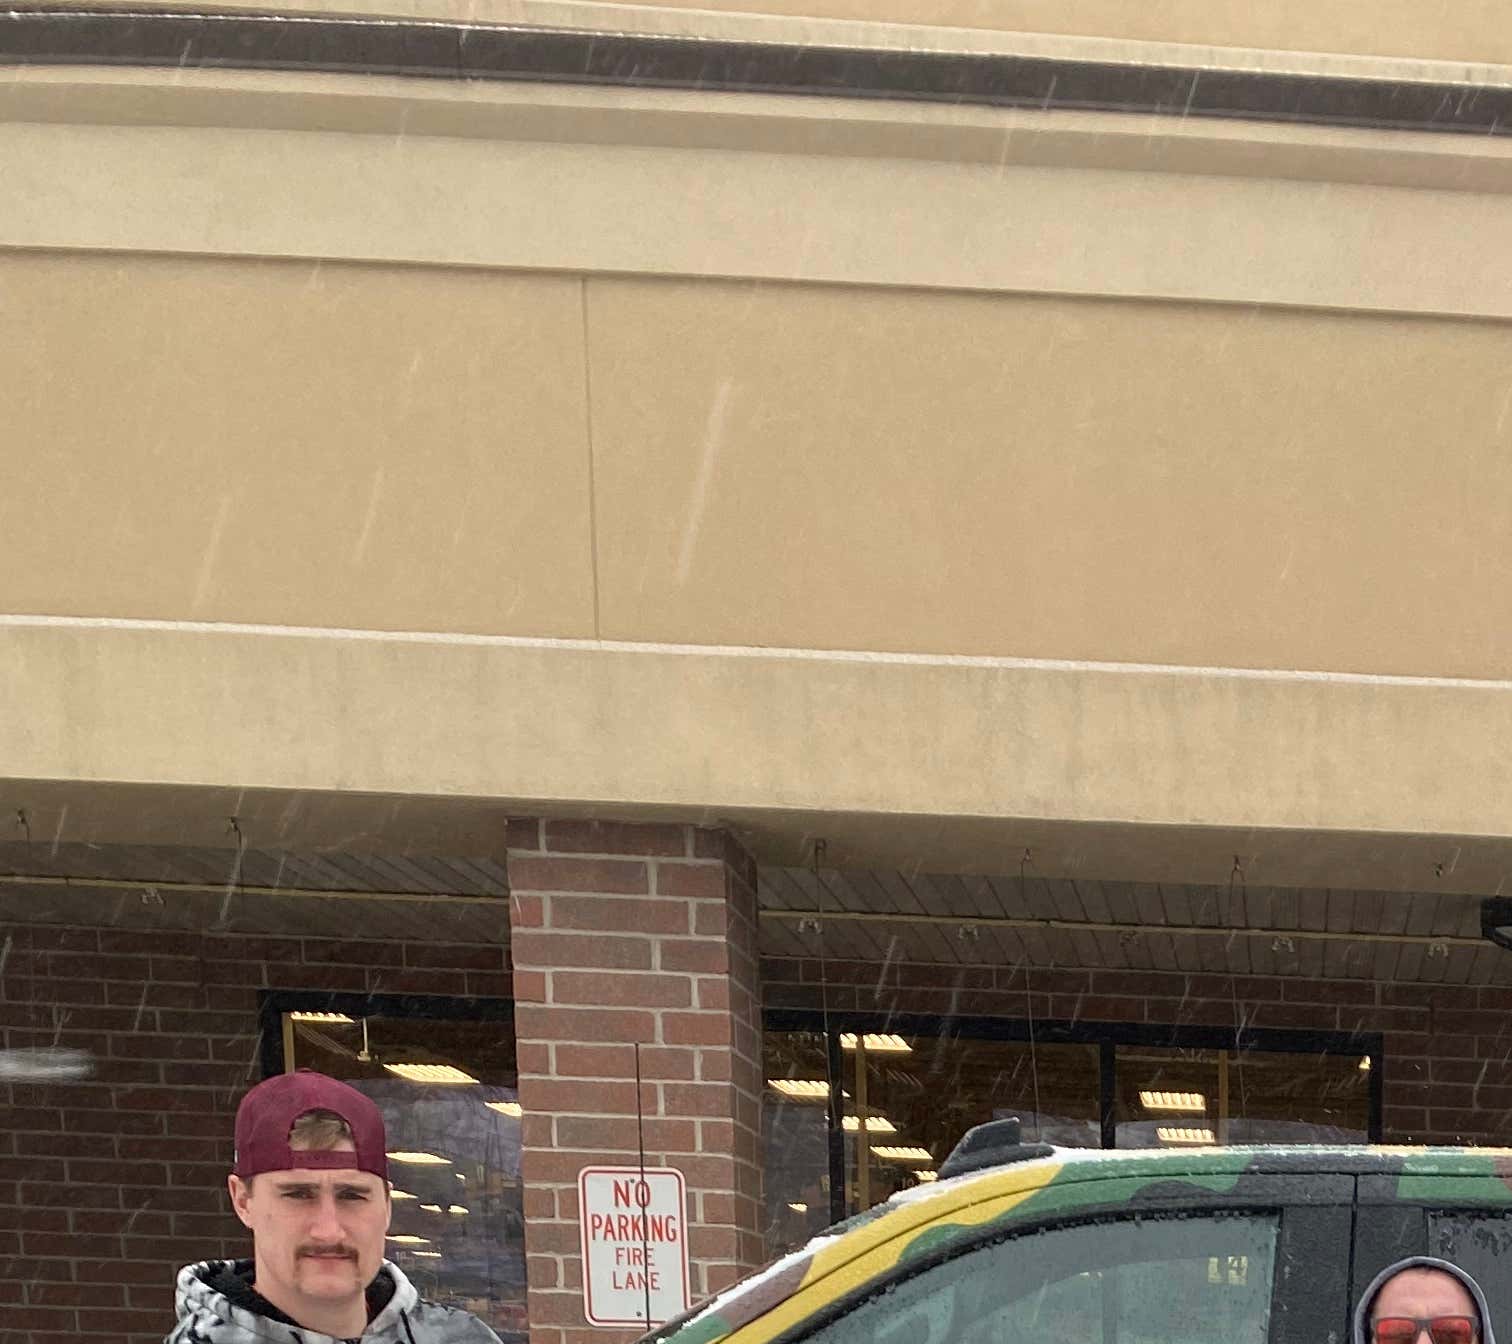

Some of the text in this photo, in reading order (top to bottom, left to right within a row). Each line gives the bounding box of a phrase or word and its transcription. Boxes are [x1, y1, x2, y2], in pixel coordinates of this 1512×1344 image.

[613, 1180, 651, 1208] NO
[591, 1213, 677, 1242] PARKING
[615, 1247, 656, 1267] FIRE
[613, 1271, 661, 1291] LANE
